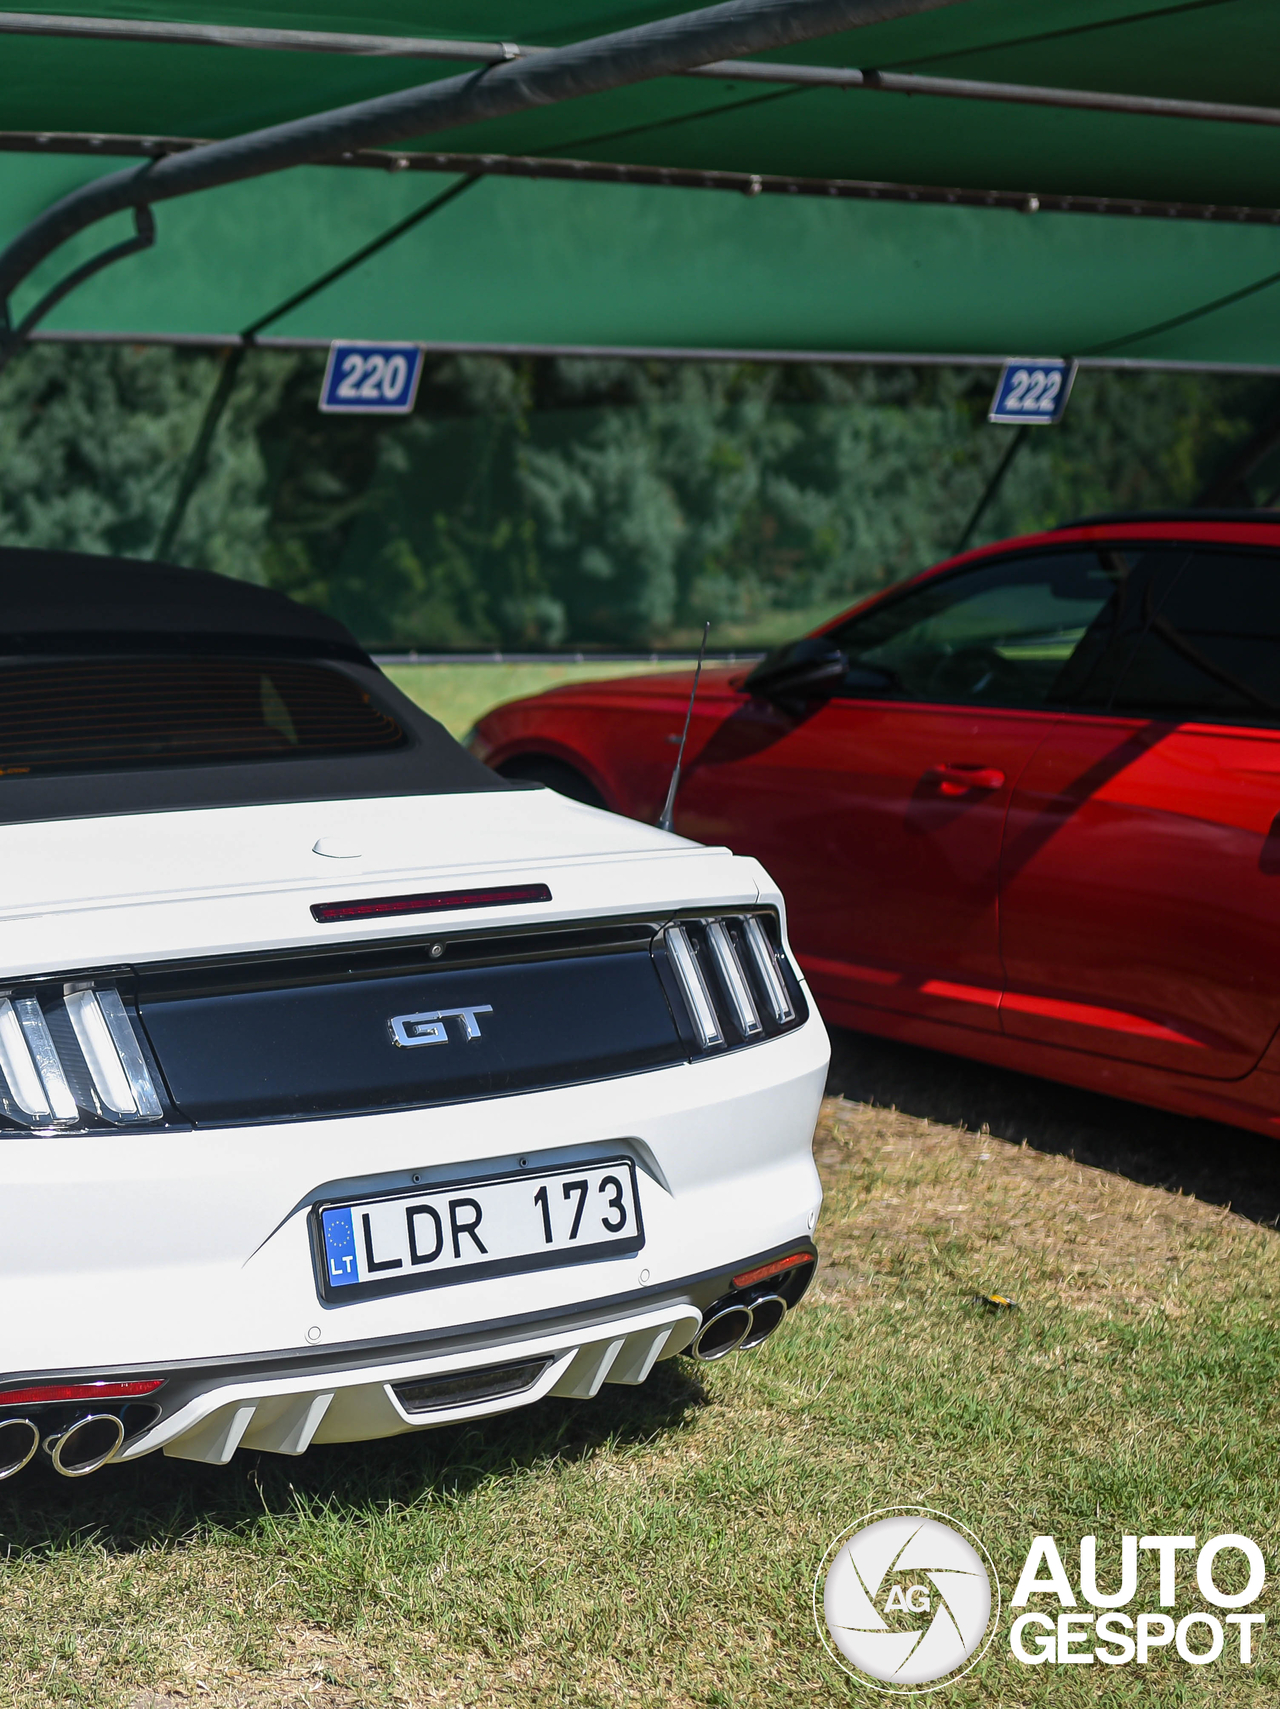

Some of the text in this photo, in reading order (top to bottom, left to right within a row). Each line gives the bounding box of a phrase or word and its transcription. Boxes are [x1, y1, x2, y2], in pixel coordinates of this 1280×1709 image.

[336, 354, 408, 400] 220
[1004, 369, 1062, 412] 222
[387, 1004, 493, 1049] GT
[362, 1175, 627, 1273] LDR 173
[330, 1255, 354, 1276] LT
